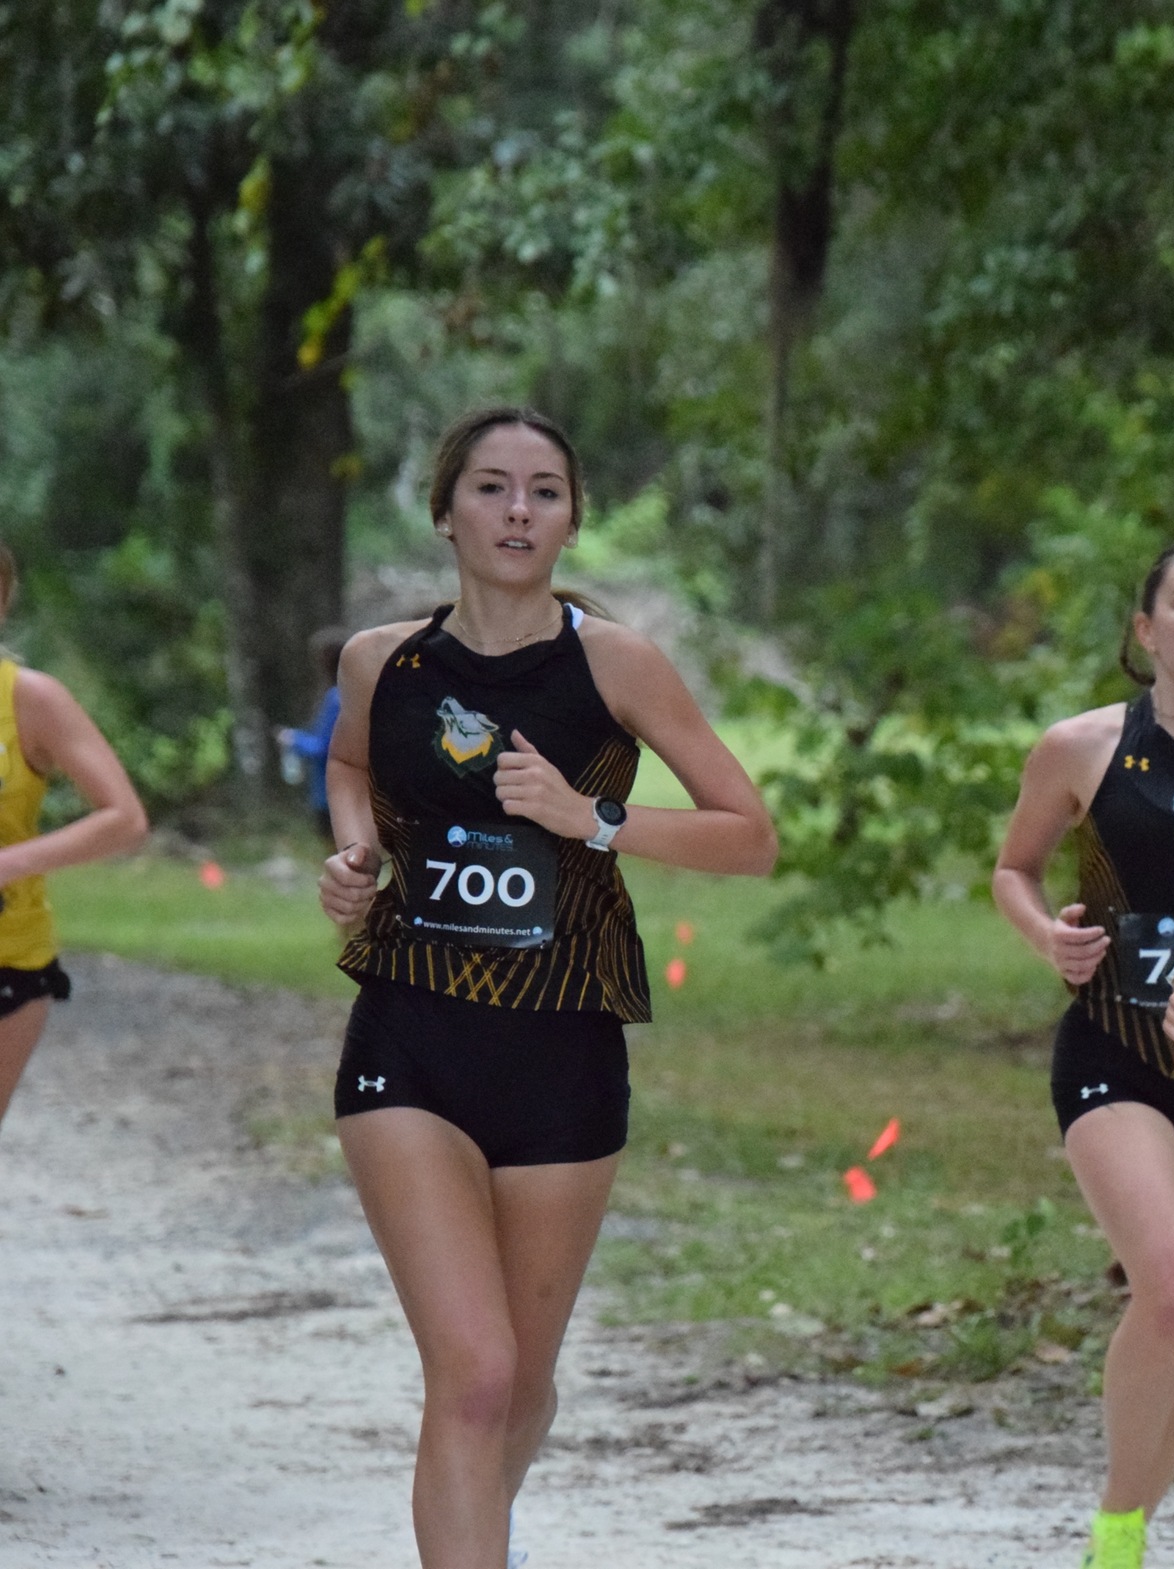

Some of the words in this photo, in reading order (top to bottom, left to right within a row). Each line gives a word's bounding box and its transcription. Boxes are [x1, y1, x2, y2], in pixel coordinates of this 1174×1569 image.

[426, 859, 536, 908] 700
[423, 920, 531, 937] www.milesandminutes.net
[1138, 948, 1172, 985] 7
